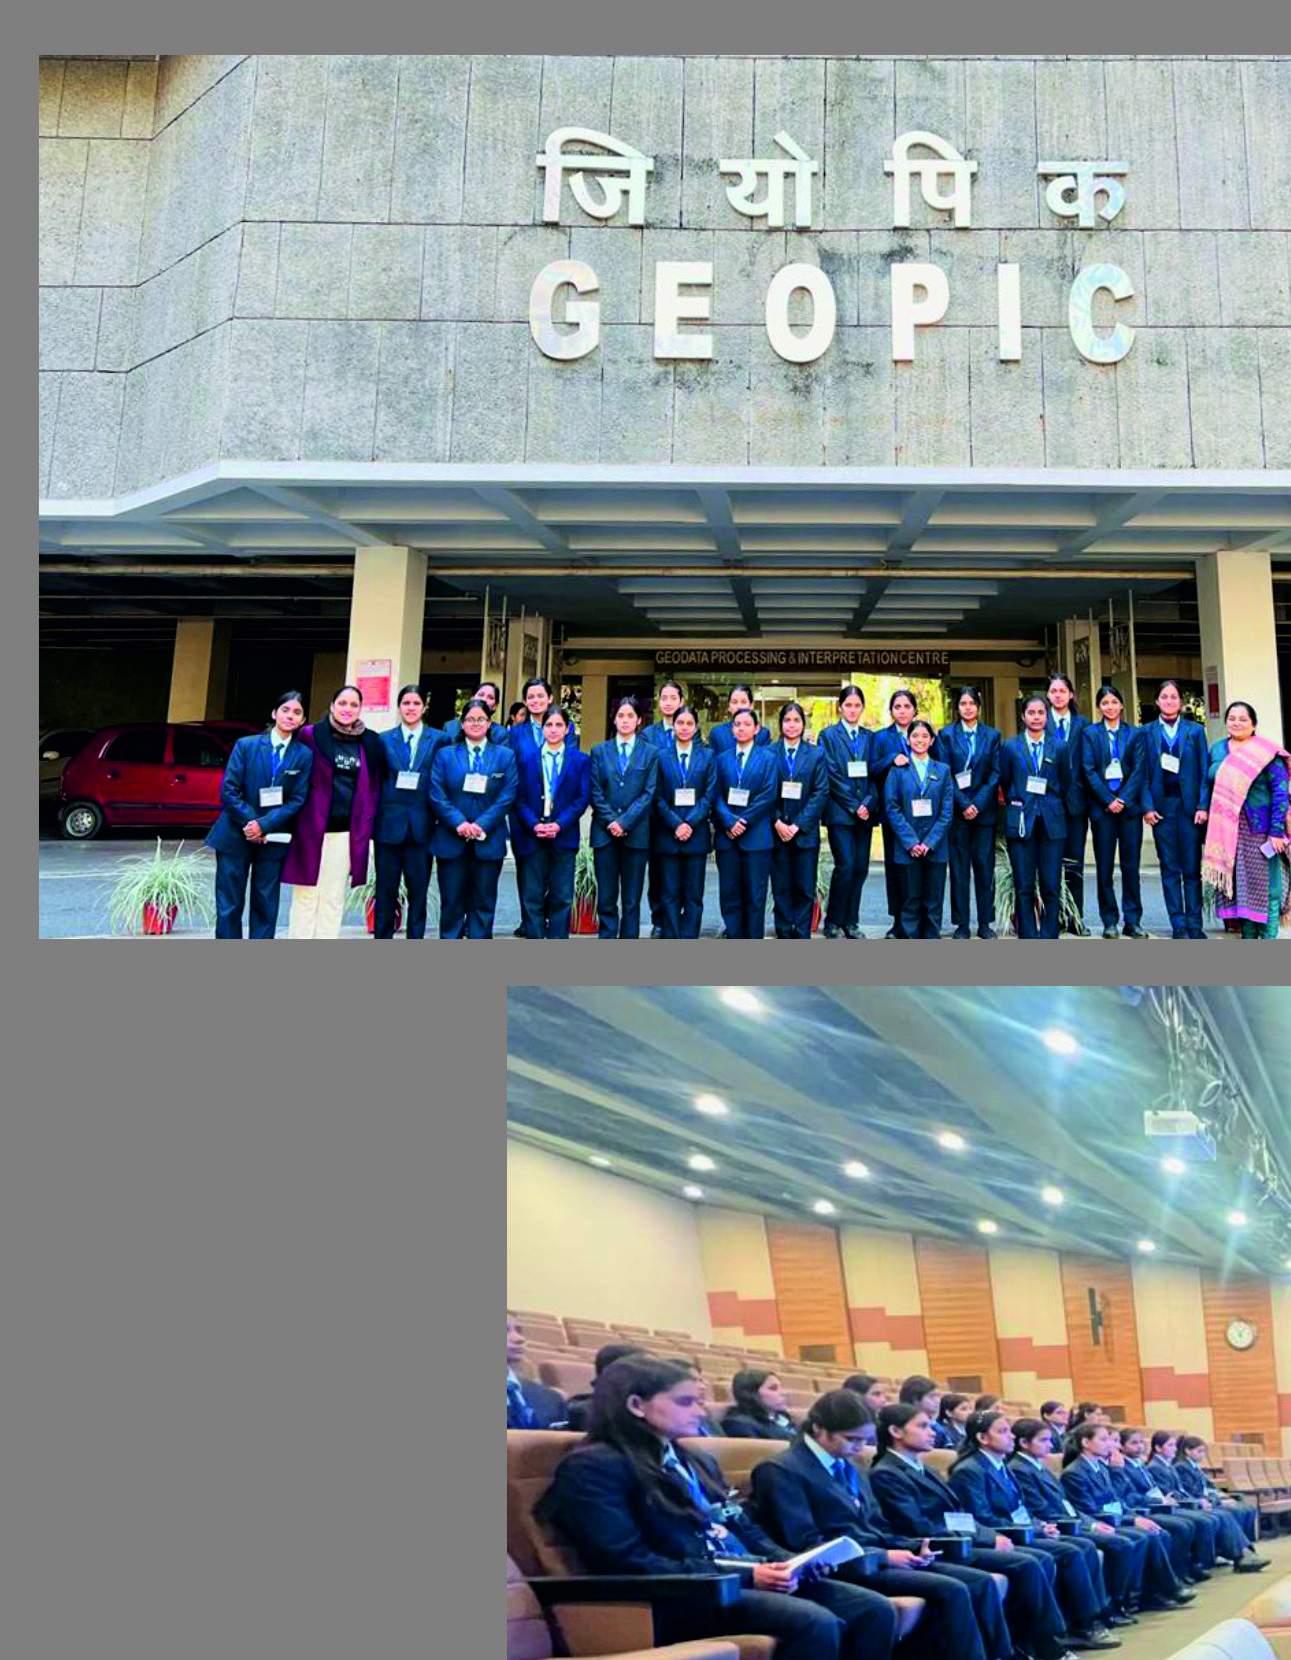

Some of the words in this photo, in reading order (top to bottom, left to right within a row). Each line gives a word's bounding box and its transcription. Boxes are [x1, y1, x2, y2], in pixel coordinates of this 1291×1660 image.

[529, 259, 1136, 364] GEOPIC
[655, 650, 709, 665] GEODATA
[710, 650, 787, 665] PROCESSING
[788, 651, 797, 665] &
[799, 650, 898, 665] INTERPRETATION
[900, 650, 949, 665] CENTRE
